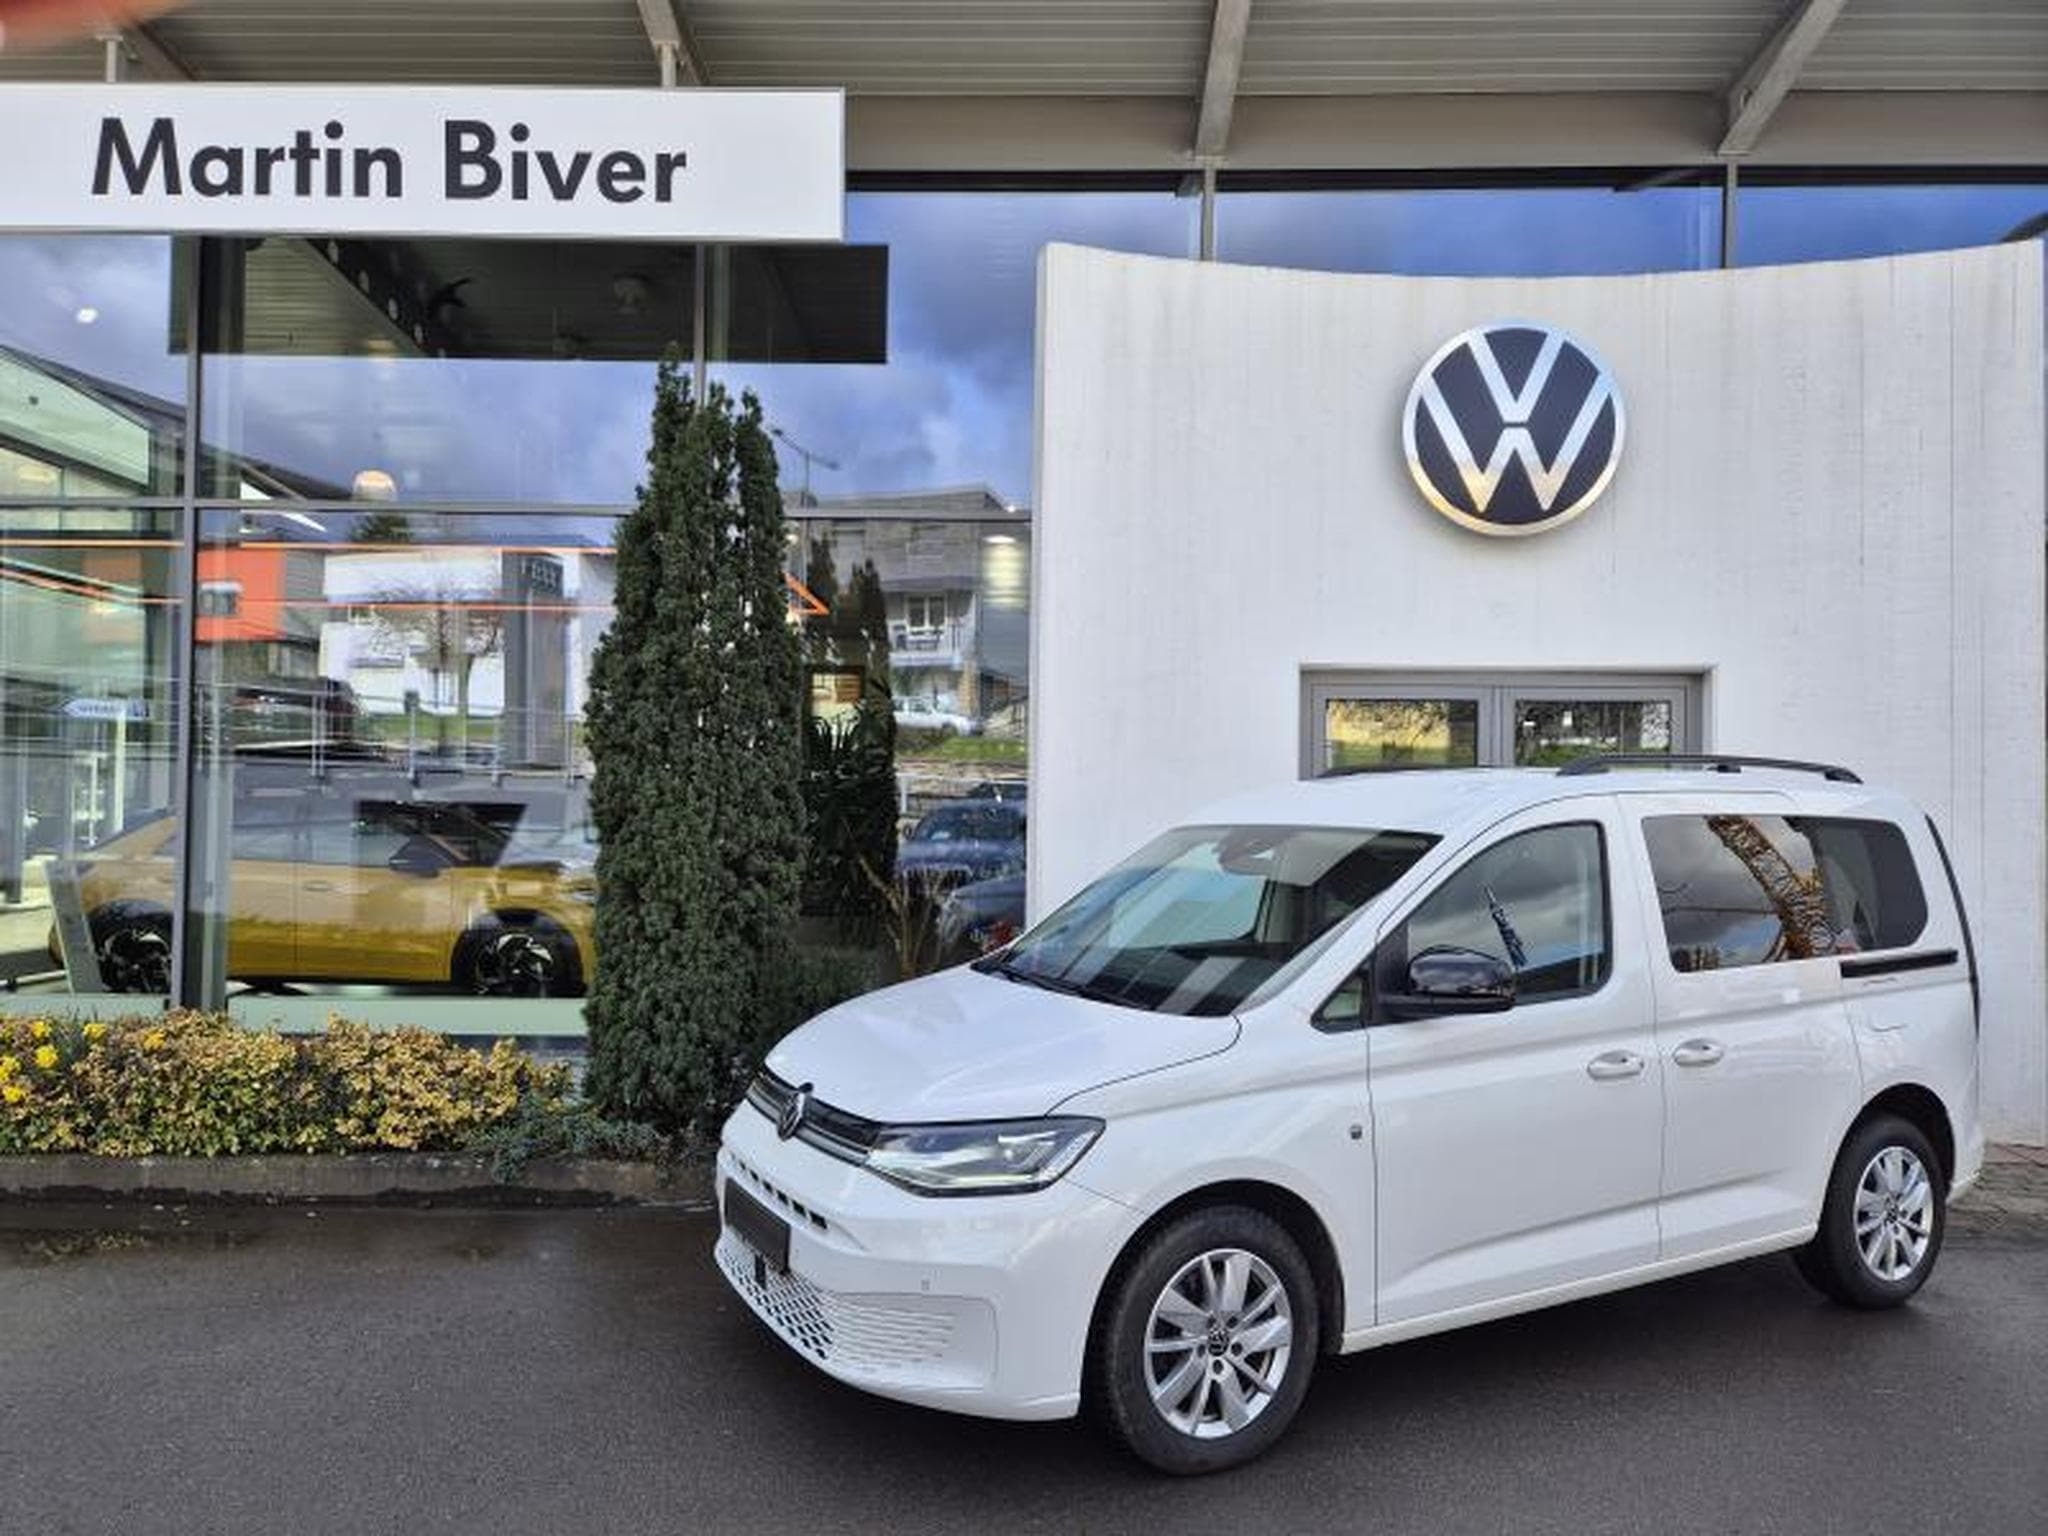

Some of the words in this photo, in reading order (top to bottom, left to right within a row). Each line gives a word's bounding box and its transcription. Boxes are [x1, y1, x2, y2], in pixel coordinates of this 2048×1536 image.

[91, 117, 402, 198] Martin
[444, 119, 687, 203] Biver
[1412, 326, 1618, 516] VW
